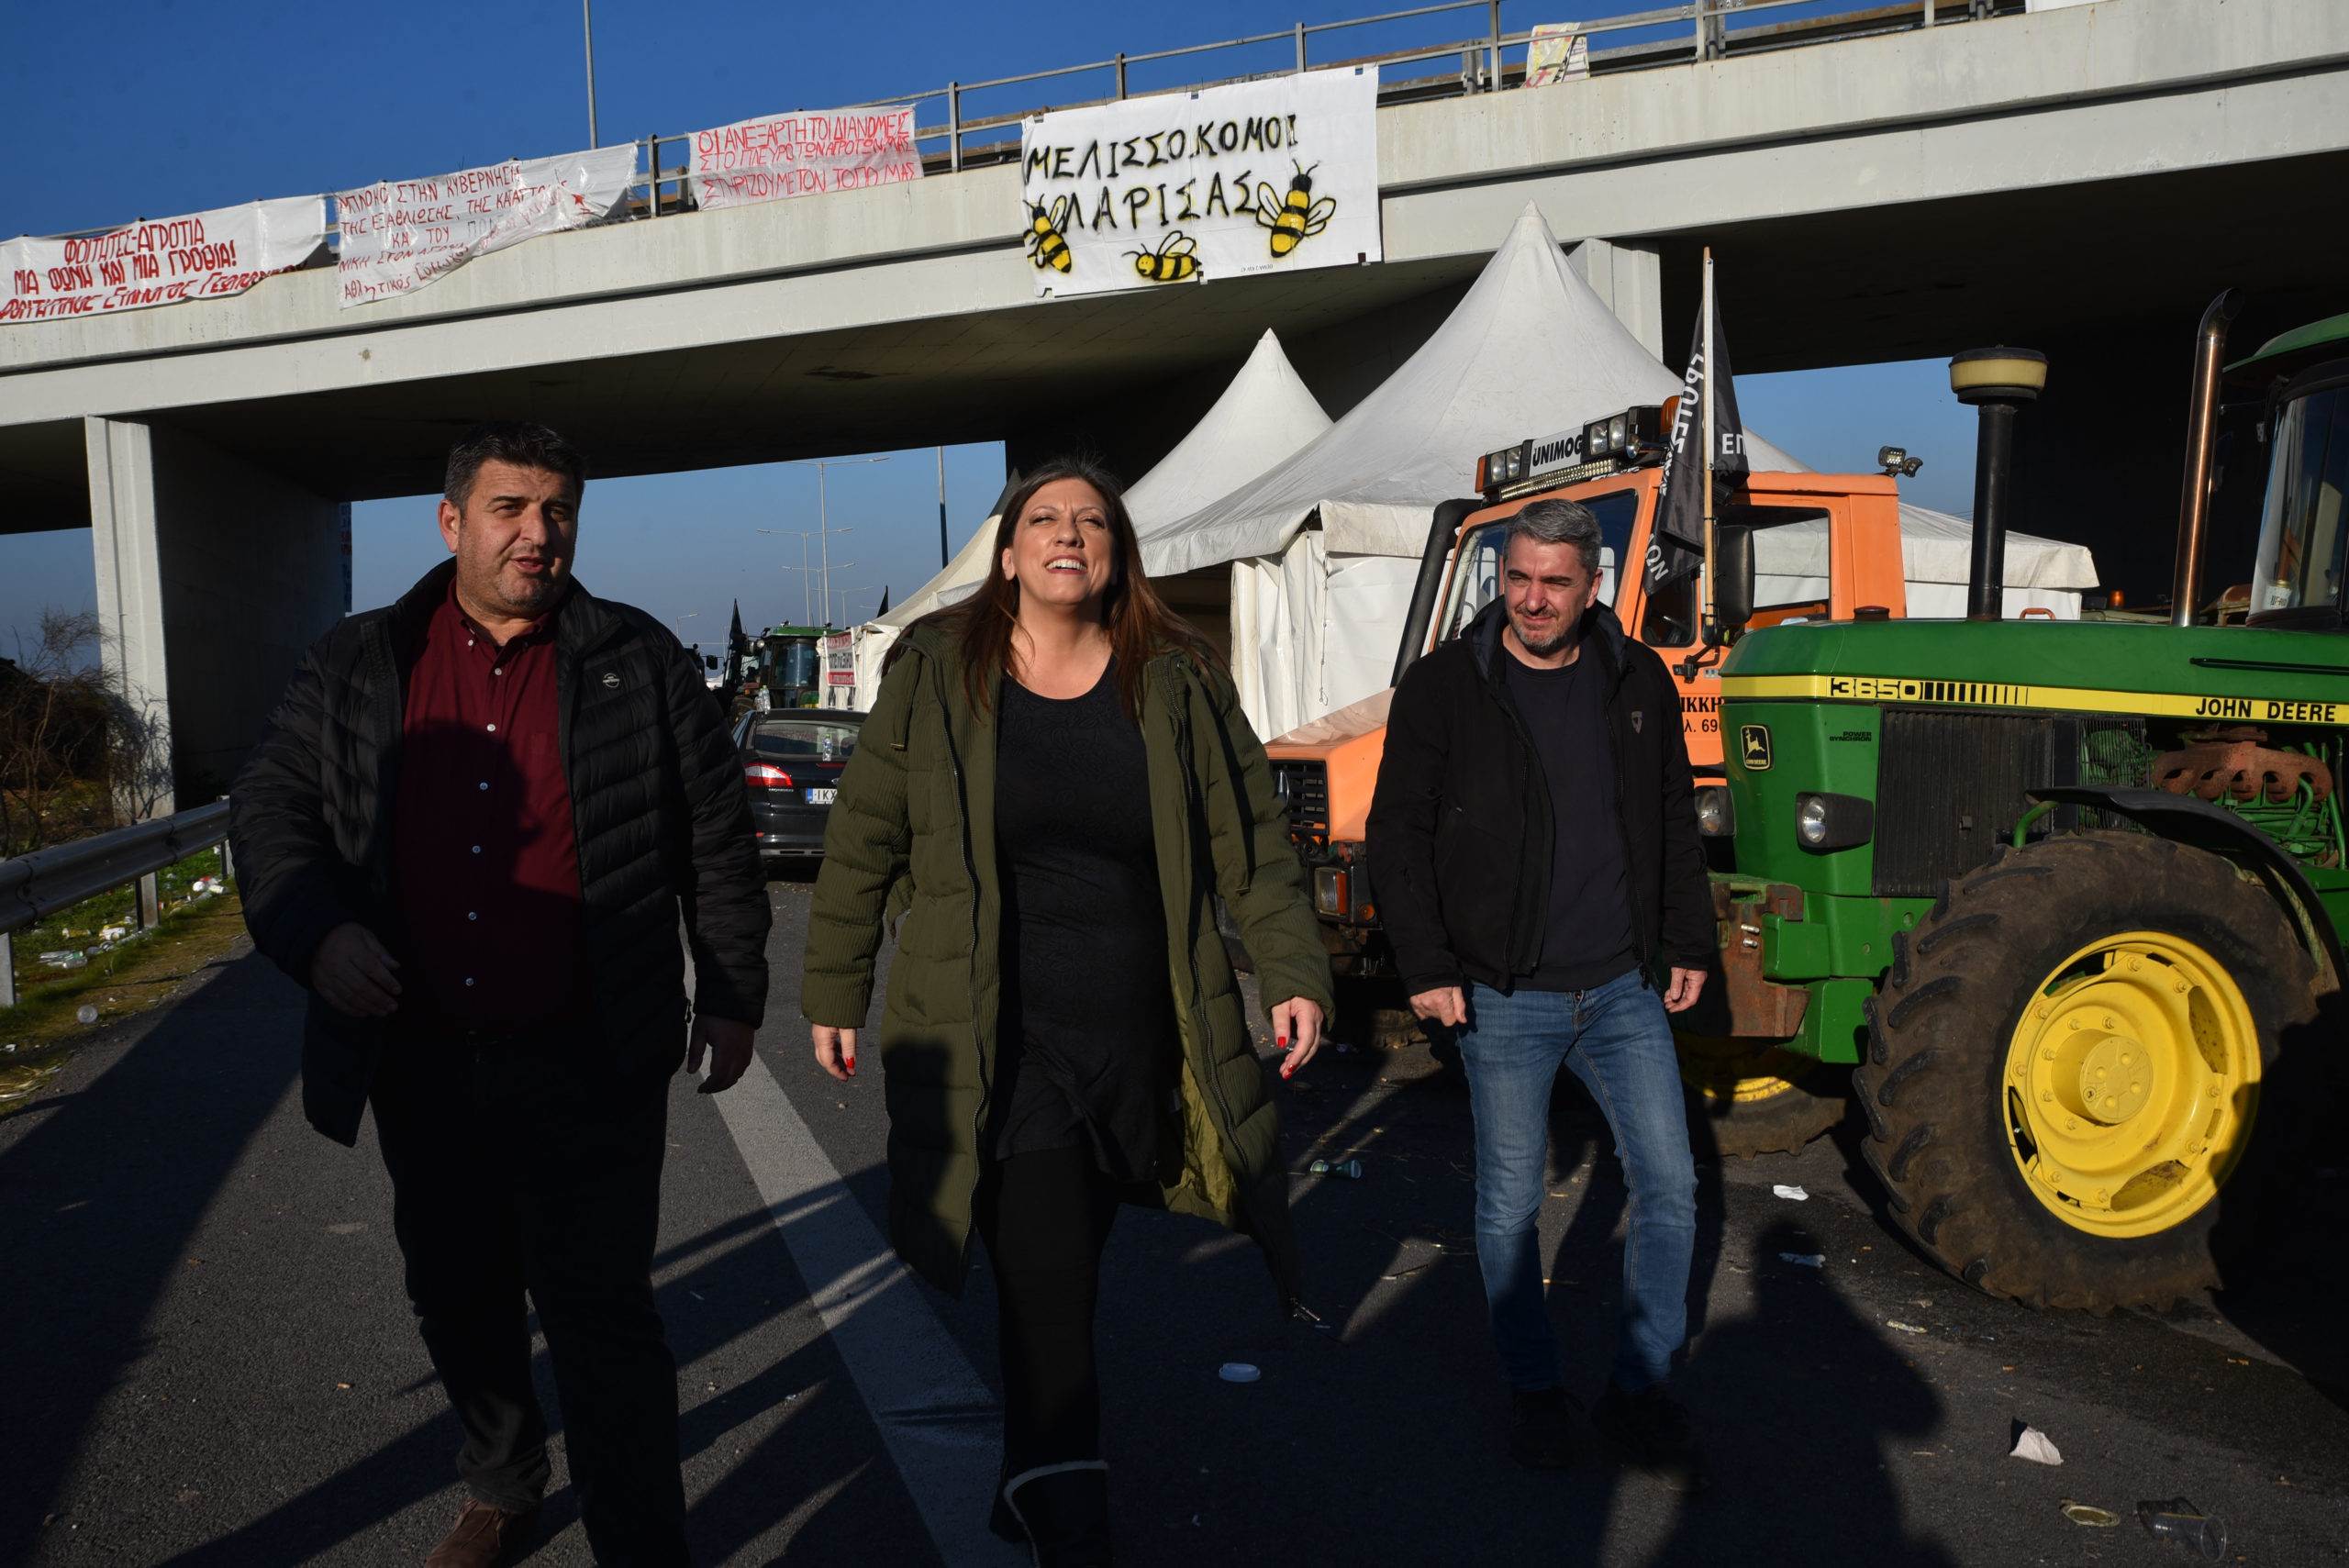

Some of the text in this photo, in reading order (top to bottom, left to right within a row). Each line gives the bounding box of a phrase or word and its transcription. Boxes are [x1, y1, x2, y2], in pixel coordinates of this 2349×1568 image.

[698, 129, 720, 155] ΟΙ
[833, 111, 910, 140] ΔΙΑΝΟΜΕΙΣ
[1026, 114, 1298, 183] ΜΕΛΙΣΣΟΚΟΜΟΙ
[699, 150, 736, 172] ΣΤΟ
[740, 143, 795, 166] ΠΛΕΥΡΟ
[397, 183, 438, 203] ΣΤΗΝ
[446, 165, 520, 198] ΚΥΒΕΡΝΗΣΗ
[796, 169, 826, 193] ΤΟΝ
[884, 161, 915, 183] ΜΑΣ
[340, 218, 367, 235] ΤΗΣ
[466, 195, 493, 215] ΤΗΣ
[1062, 171, 1257, 230] ΛΑΡΙΣΑΣ
[426, 227, 450, 244] ΤΟΥ
[15, 269, 39, 295] ΜΙΑ
[48, 263, 93, 292] ΦΩΝΗ
[99, 259, 125, 286] ΚΑΙ
[133, 254, 160, 280] ΜΙΑ
[339, 256, 371, 273] ΝΙΚΗ
[1532, 434, 1583, 466] UNIMOG
[1831, 677, 1921, 700] 3650
[2196, 698, 2336, 722] JOHN DEERE
